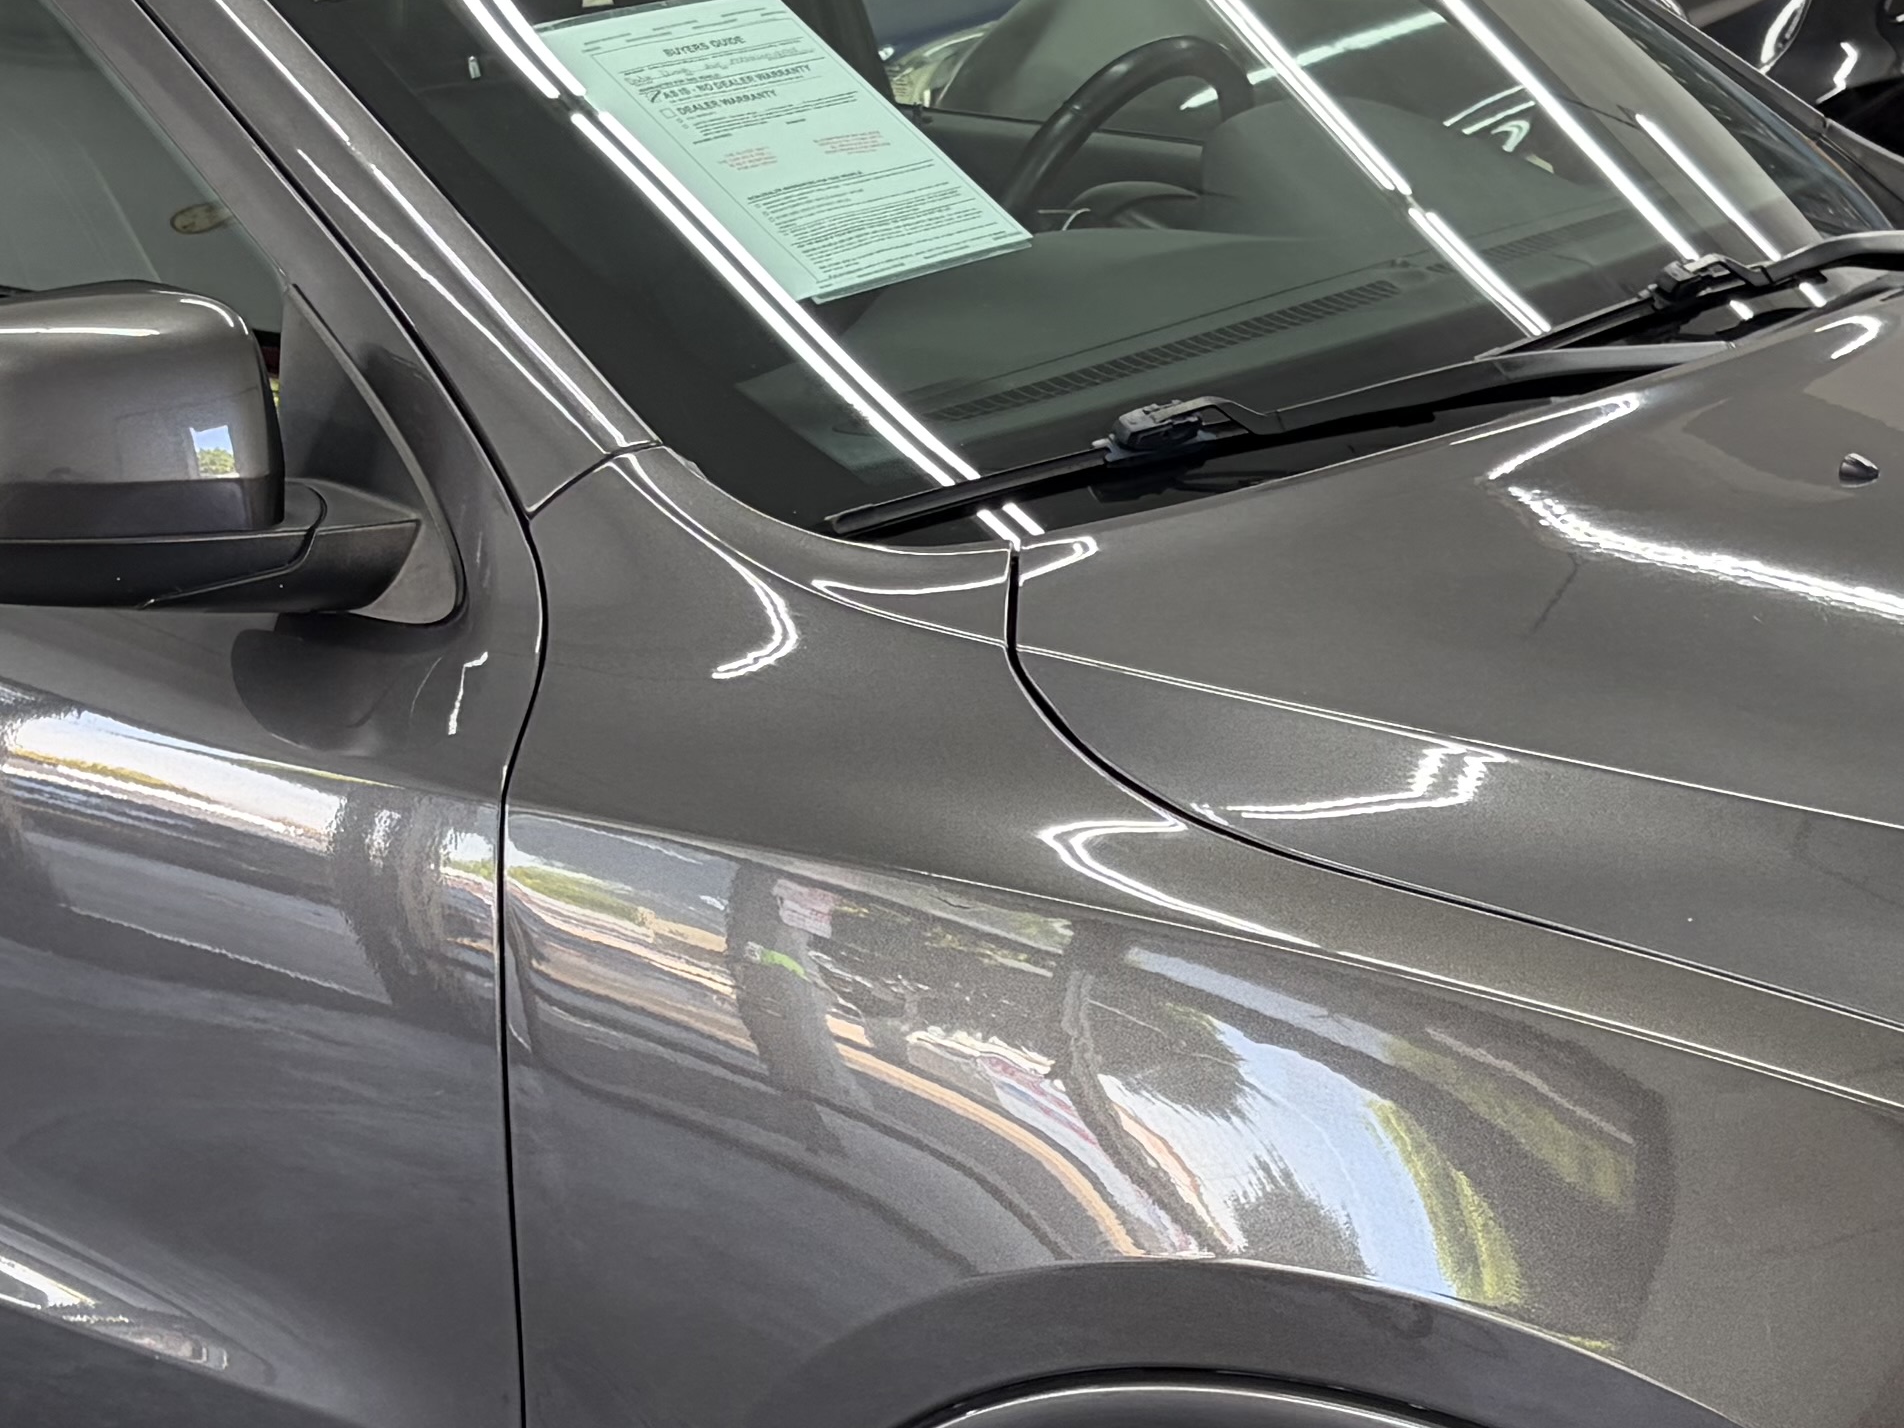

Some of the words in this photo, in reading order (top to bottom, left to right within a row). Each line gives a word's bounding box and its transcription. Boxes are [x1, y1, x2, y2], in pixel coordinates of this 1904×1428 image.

[663, 42, 710, 57] BUYERS
[663, 89, 679, 100] AS
[696, 82, 714, 92] NO
[713, 75, 755, 89] DEALER
[754, 63, 812, 84] WARRANTY
[676, 99, 723, 116] DEALER
[721, 89, 779, 109] WARRANTY
